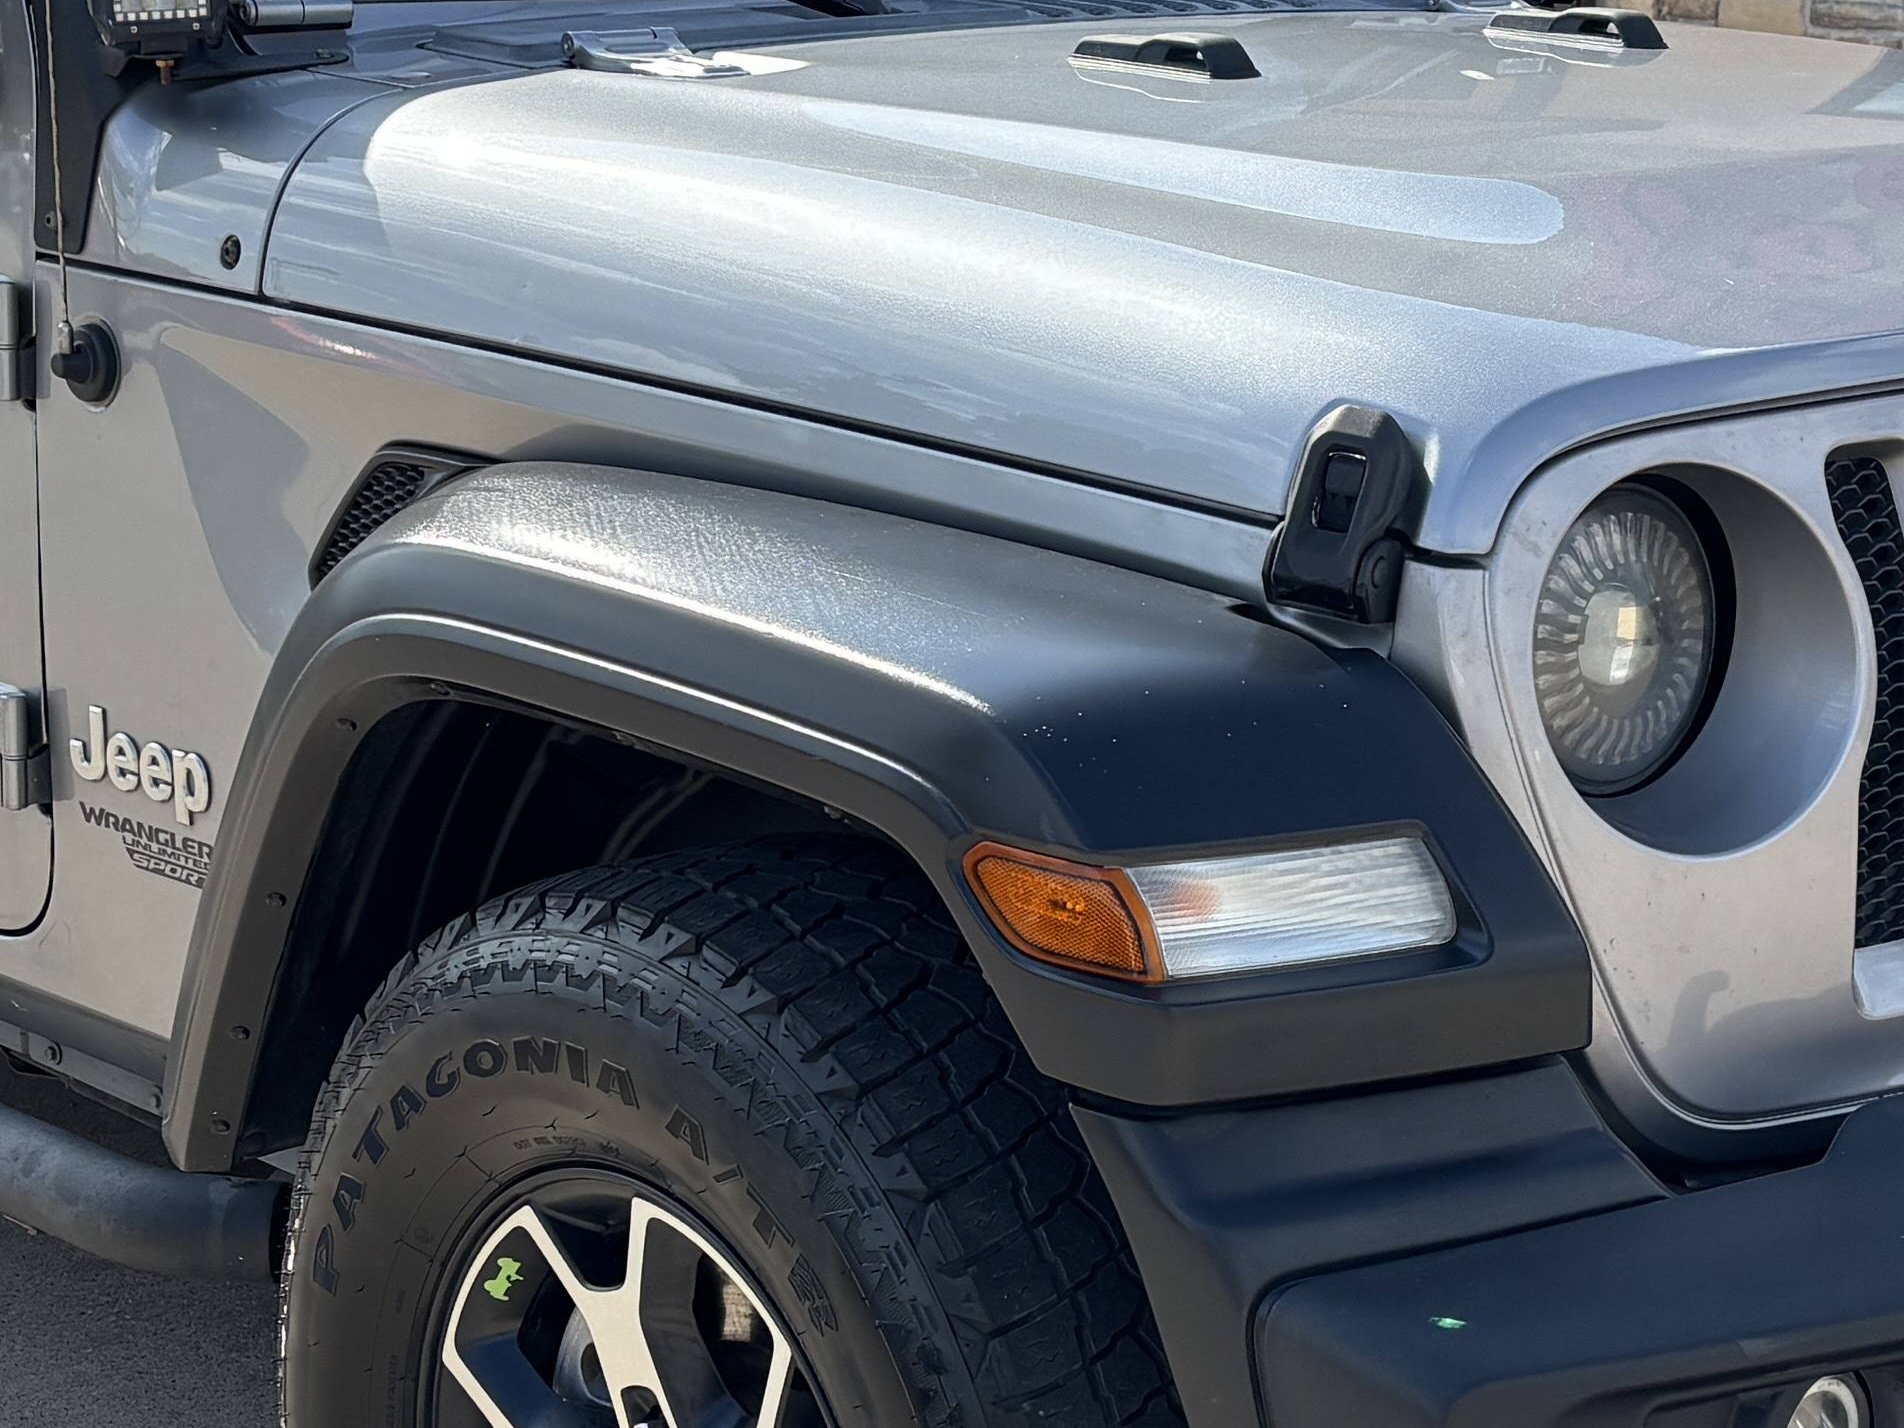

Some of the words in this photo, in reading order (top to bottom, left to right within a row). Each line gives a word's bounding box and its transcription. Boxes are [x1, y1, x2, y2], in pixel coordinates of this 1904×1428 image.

[69, 704, 212, 827] Jeep
[79, 800, 215, 862] WRANGLER
[130, 851, 208, 888] SPOR
[313, 1035, 641, 1297] PATAGONIA
